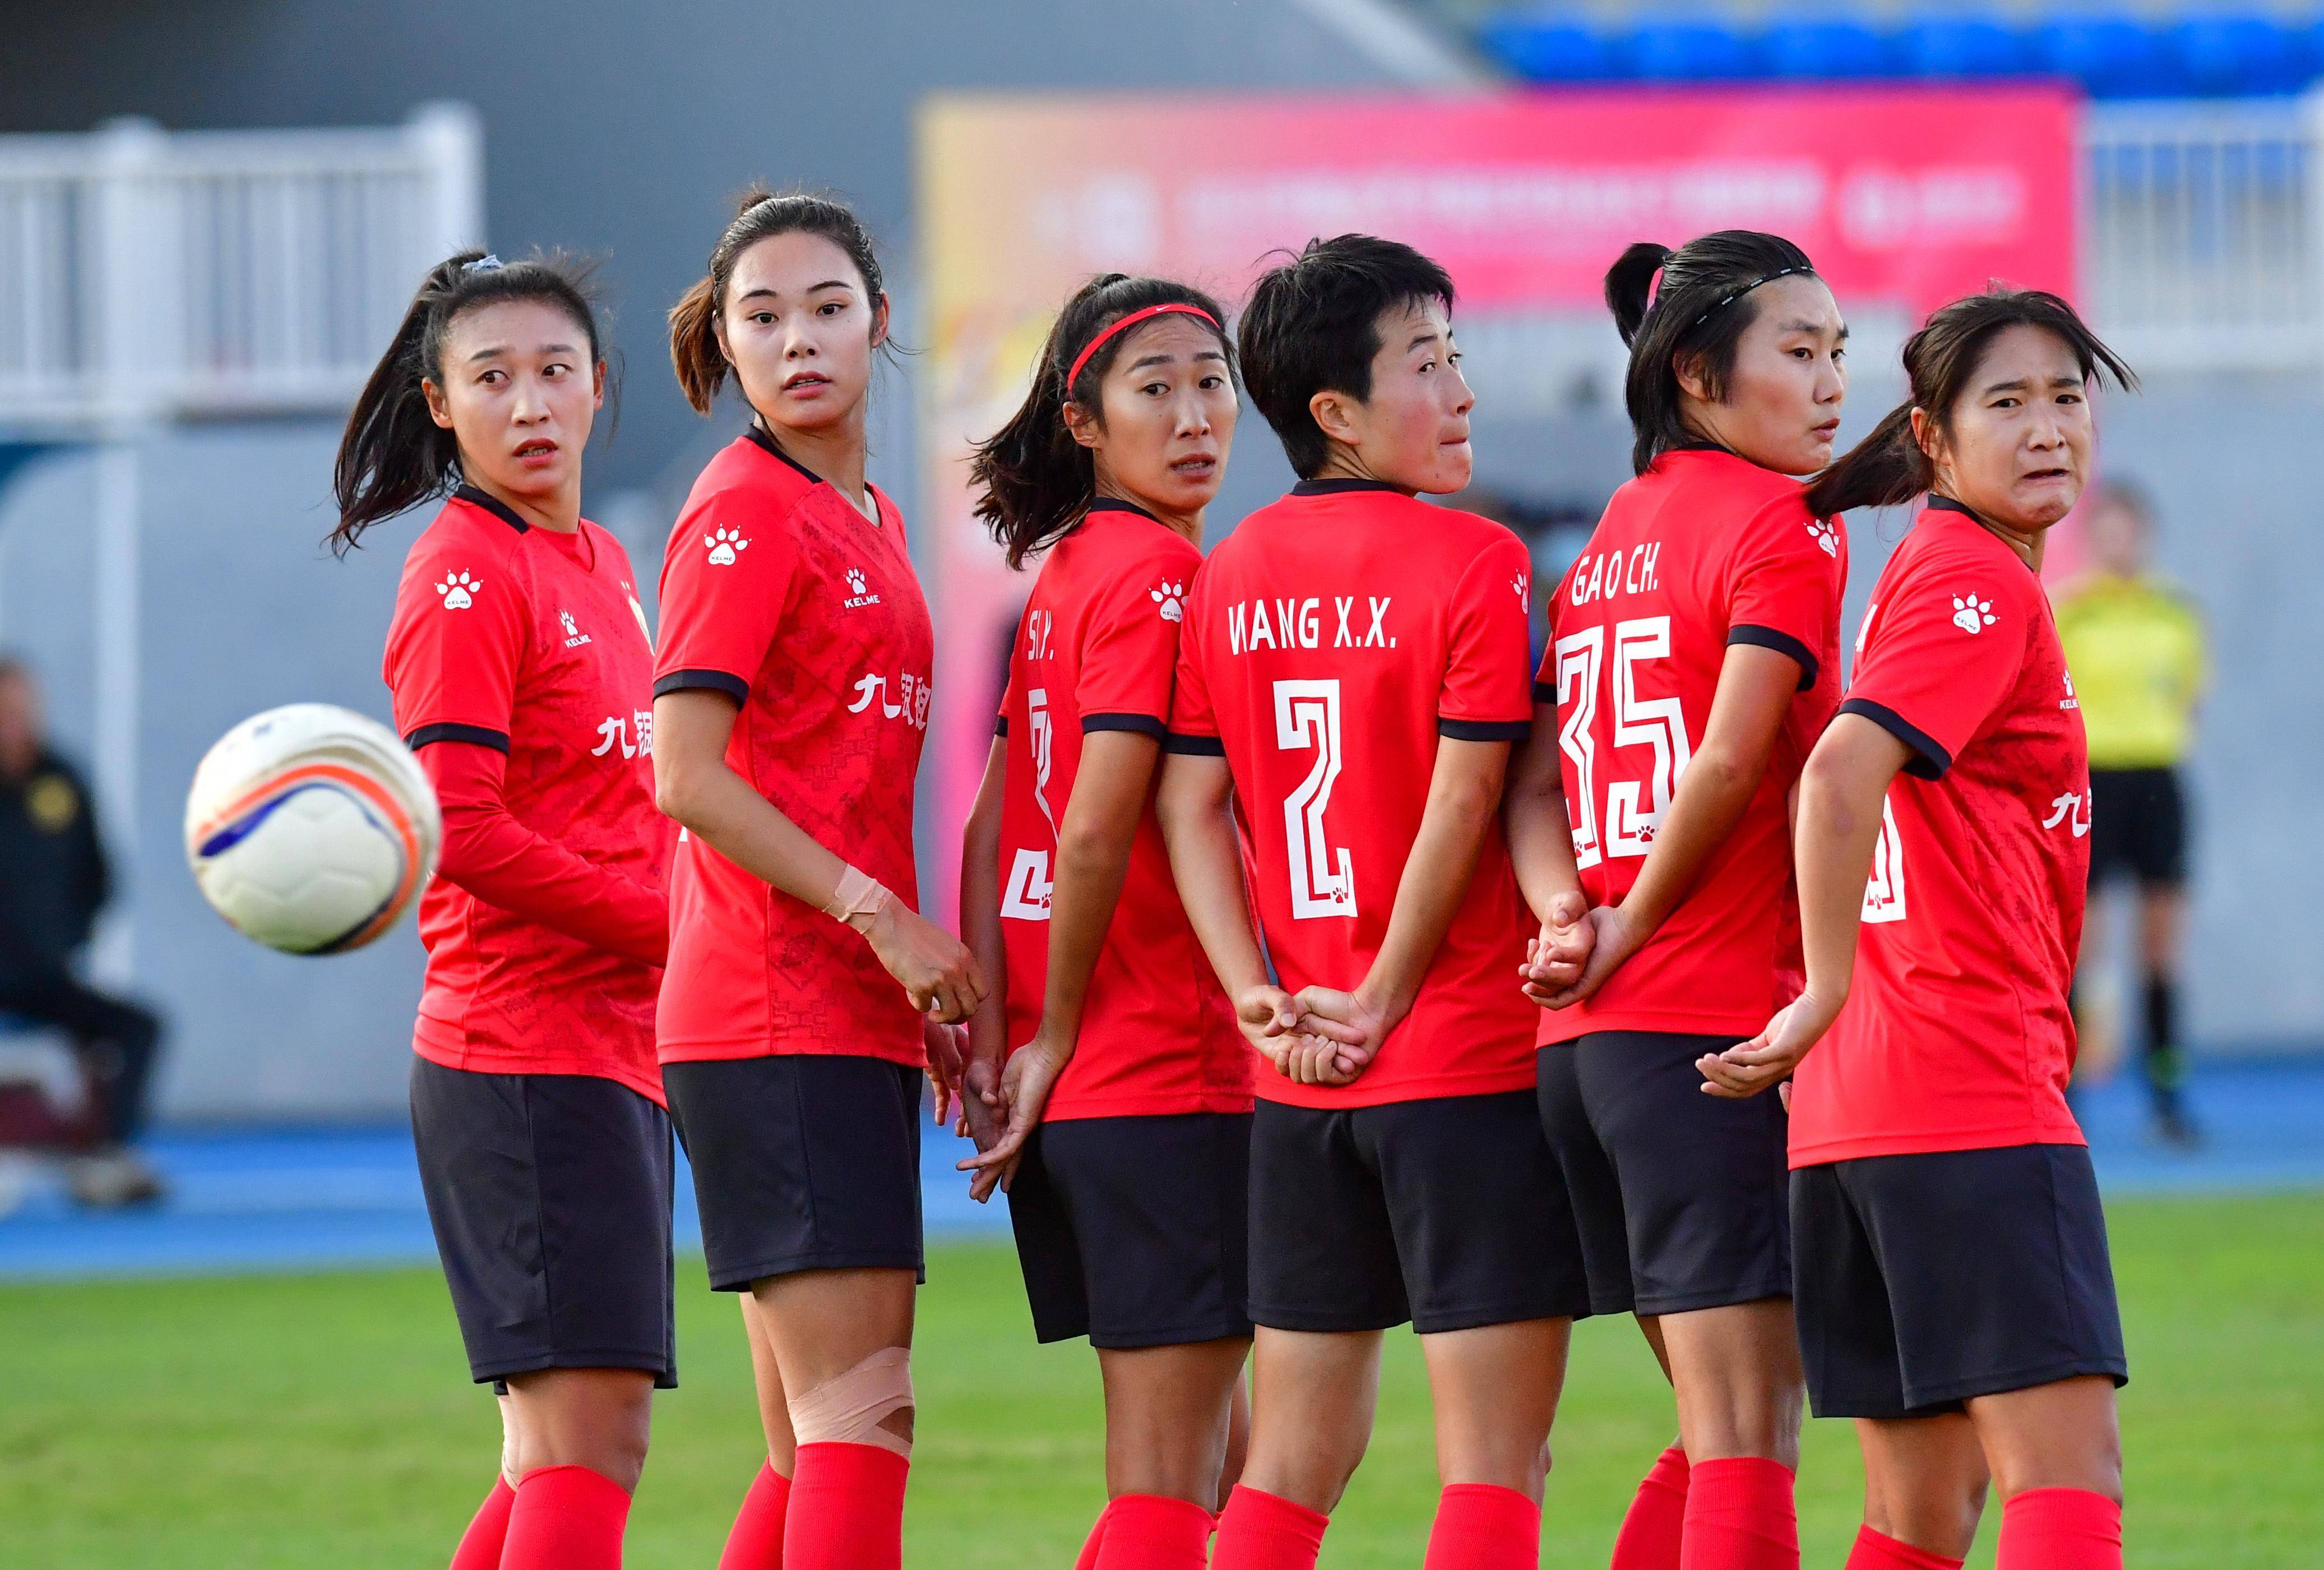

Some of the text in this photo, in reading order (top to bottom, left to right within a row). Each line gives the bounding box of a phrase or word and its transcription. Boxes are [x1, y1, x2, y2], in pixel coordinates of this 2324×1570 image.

[1571, 542, 1661, 607] GAO CH.
[844, 594, 881, 609] KELME
[1333, 596, 1396, 648] X.X.
[1956, 617, 1977, 630] KELME
[564, 634, 592, 648] KELME
[1555, 615, 1691, 872] 35
[1272, 679, 1358, 920] 2
